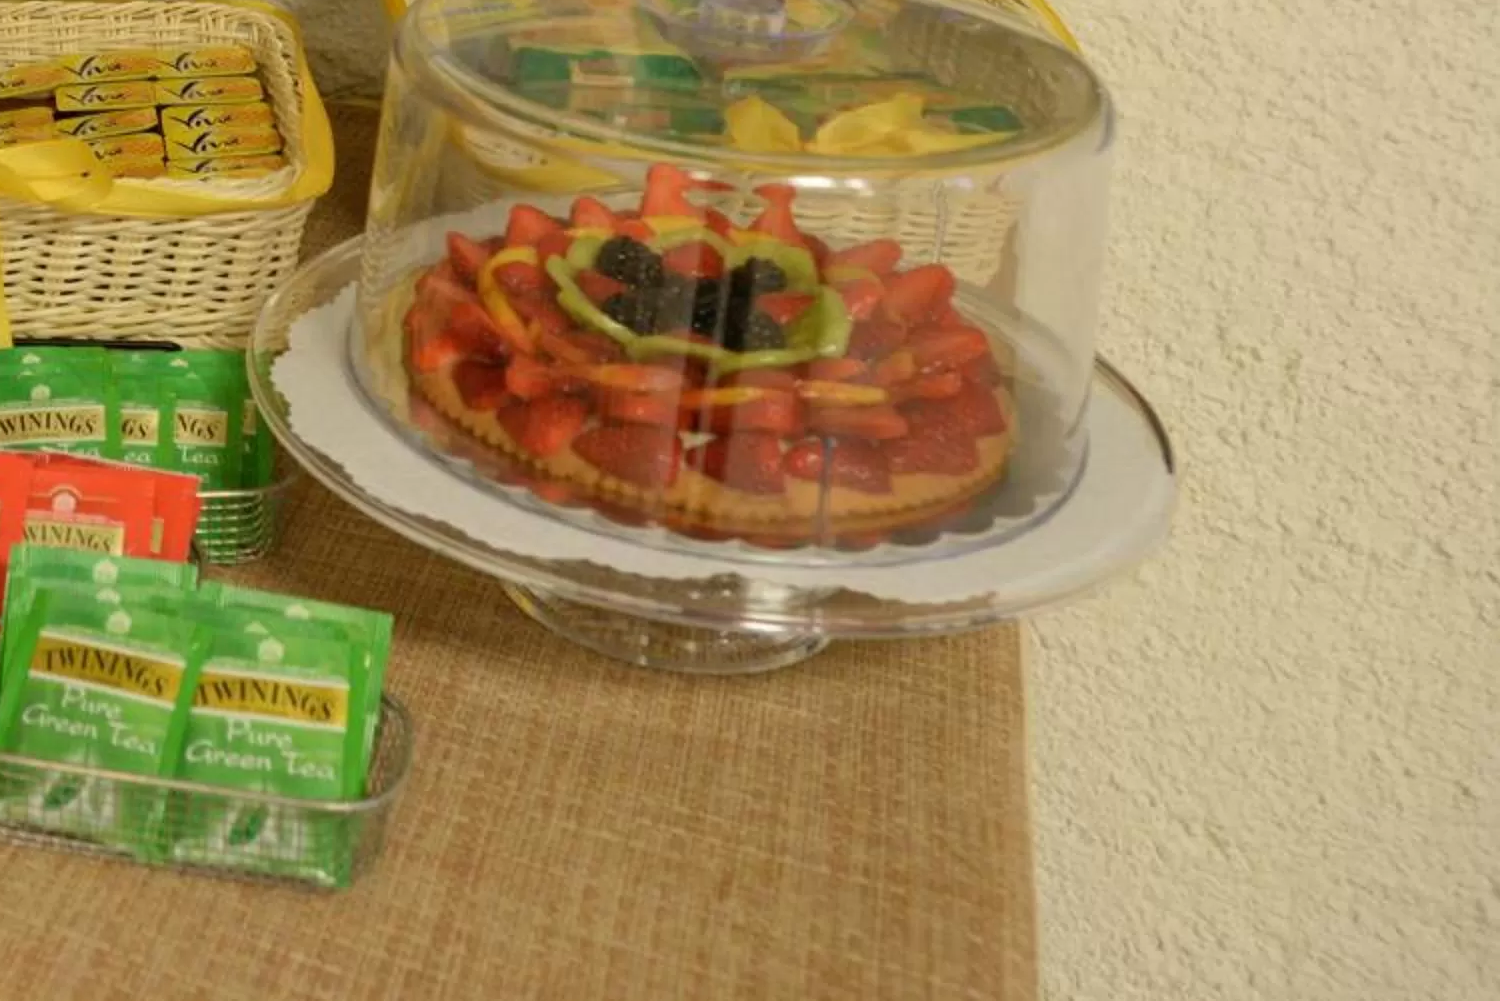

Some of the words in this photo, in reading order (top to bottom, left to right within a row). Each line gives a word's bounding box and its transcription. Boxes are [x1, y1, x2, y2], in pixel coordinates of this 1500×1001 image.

[23, 523, 113, 552] WININGS
[44, 644, 170, 696] TWININGS
[60, 683, 122, 721] Pure
[195, 678, 336, 722] TWININGS
[22, 703, 98, 739] Green
[110, 721, 157, 756] Tea
[227, 718, 293, 749] Pure
[185, 739, 273, 772] Green
[280, 748, 336, 781] Tea
